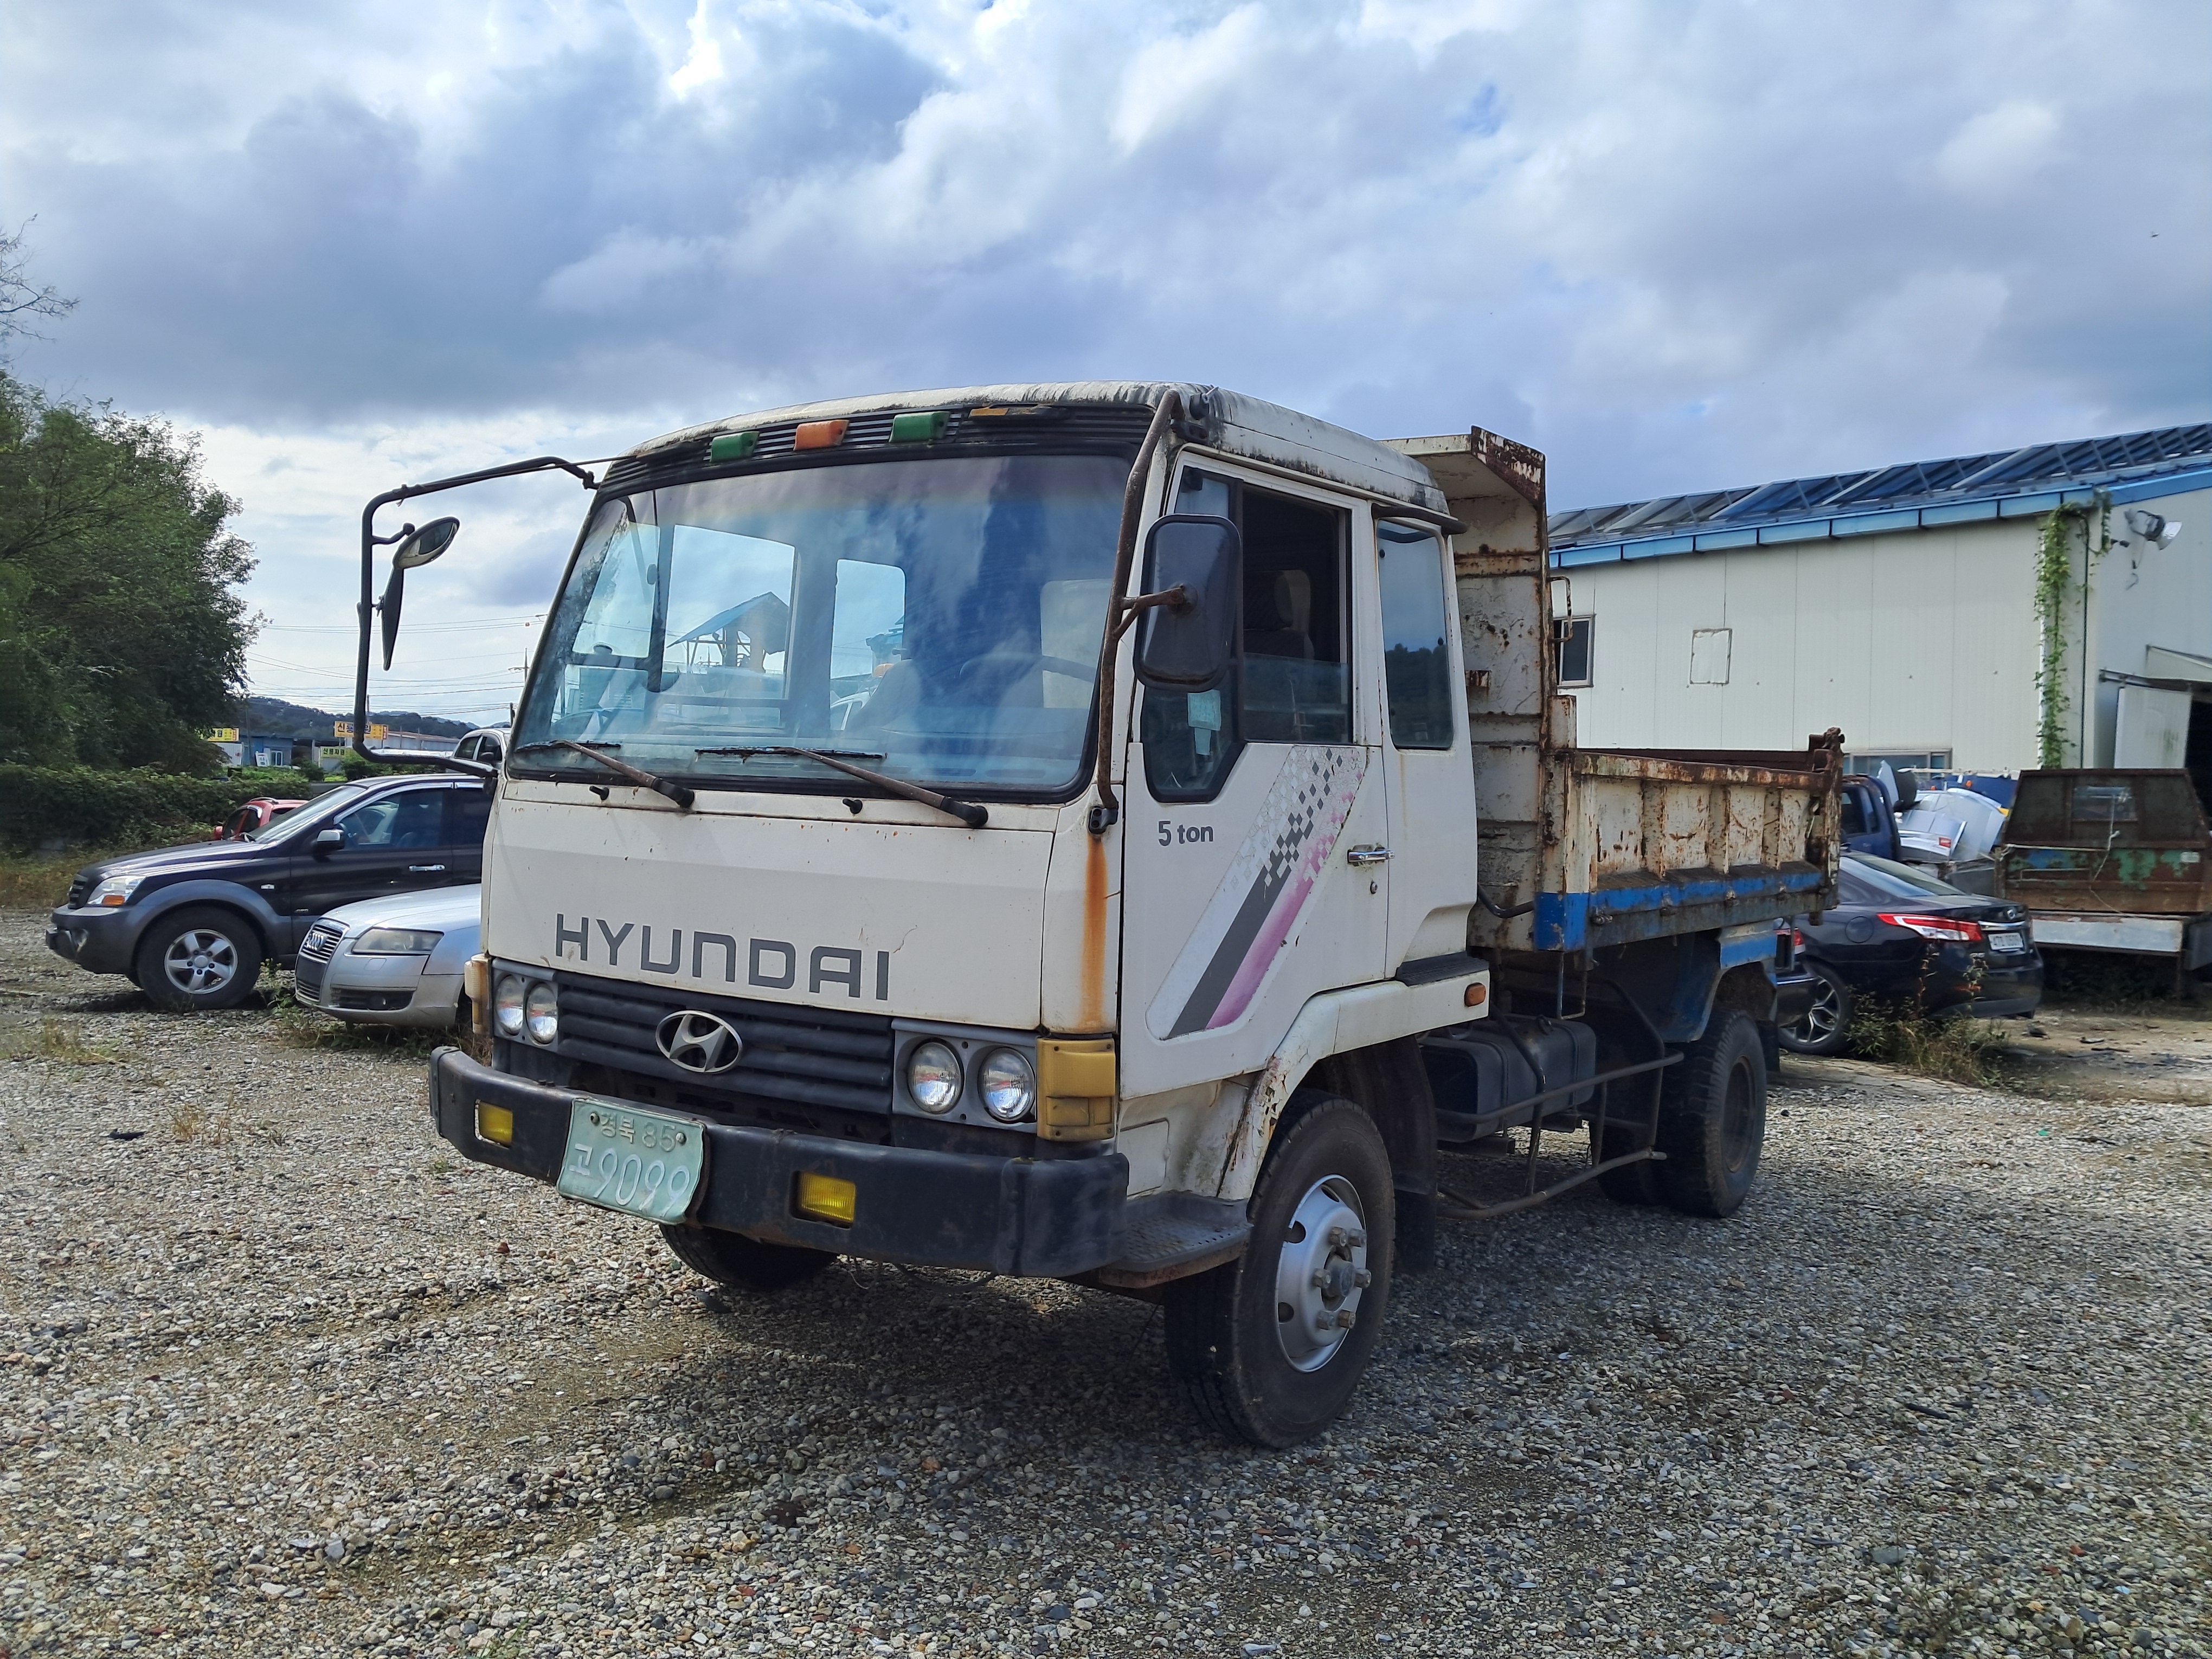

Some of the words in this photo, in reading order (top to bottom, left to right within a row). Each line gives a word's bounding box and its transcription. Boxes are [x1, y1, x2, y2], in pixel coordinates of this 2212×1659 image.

[1158, 820, 1172, 847] 5
[1177, 824, 1214, 844] ton
[556, 913, 890, 1001] HYUNDAI
[600, 1112, 635, 1144] 경북
[642, 1122, 676, 1153] 85
